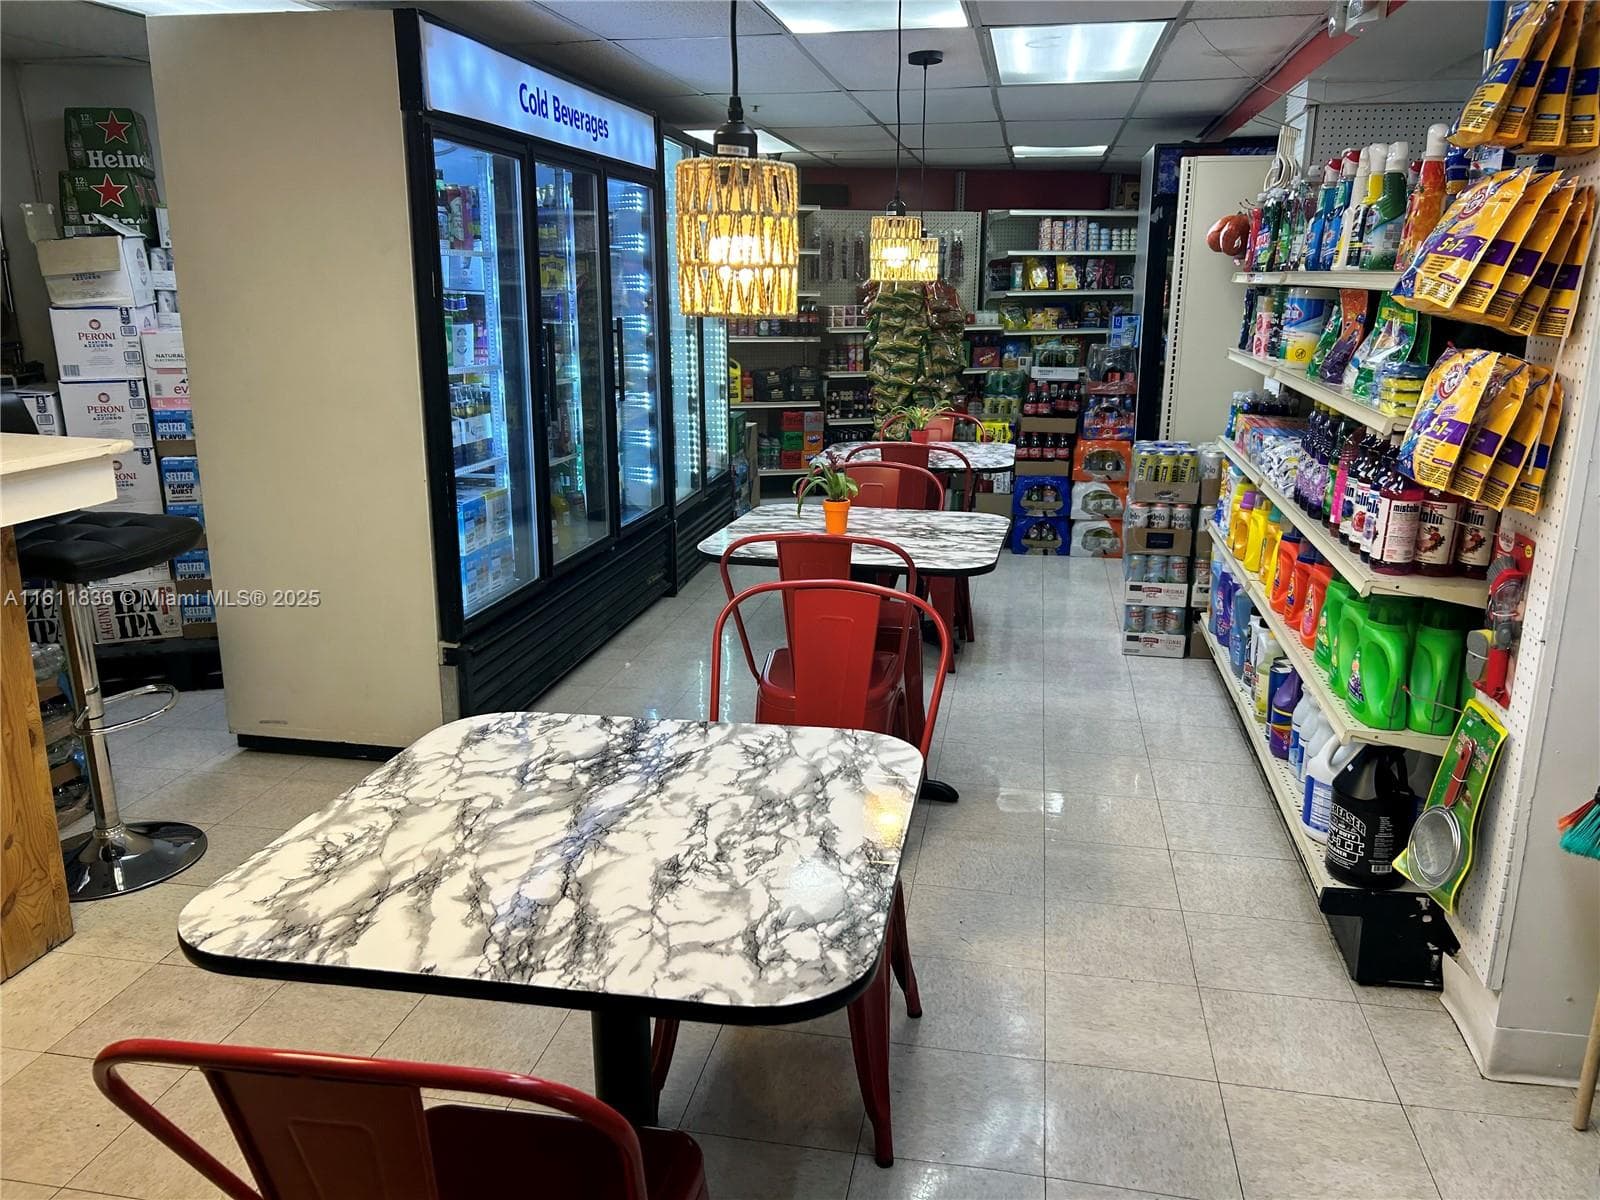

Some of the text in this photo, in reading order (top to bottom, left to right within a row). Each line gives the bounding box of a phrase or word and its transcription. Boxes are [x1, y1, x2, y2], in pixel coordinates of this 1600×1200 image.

[518, 82, 609, 142] Cold Beverages
[78, 331, 116, 341] PERONI
[87, 405, 126, 414] PERONI
[157, 422, 187, 433] SELTZER
[1105, 462, 1113, 471] G
[114, 472, 137, 480] RONI
[165, 471, 195, 482] SELTZER
[176, 562, 206, 572] SELTZER
[183, 606, 213, 617] SELTZER
[116, 613, 162, 639] IPA
[1332, 802, 1367, 837] REASER
